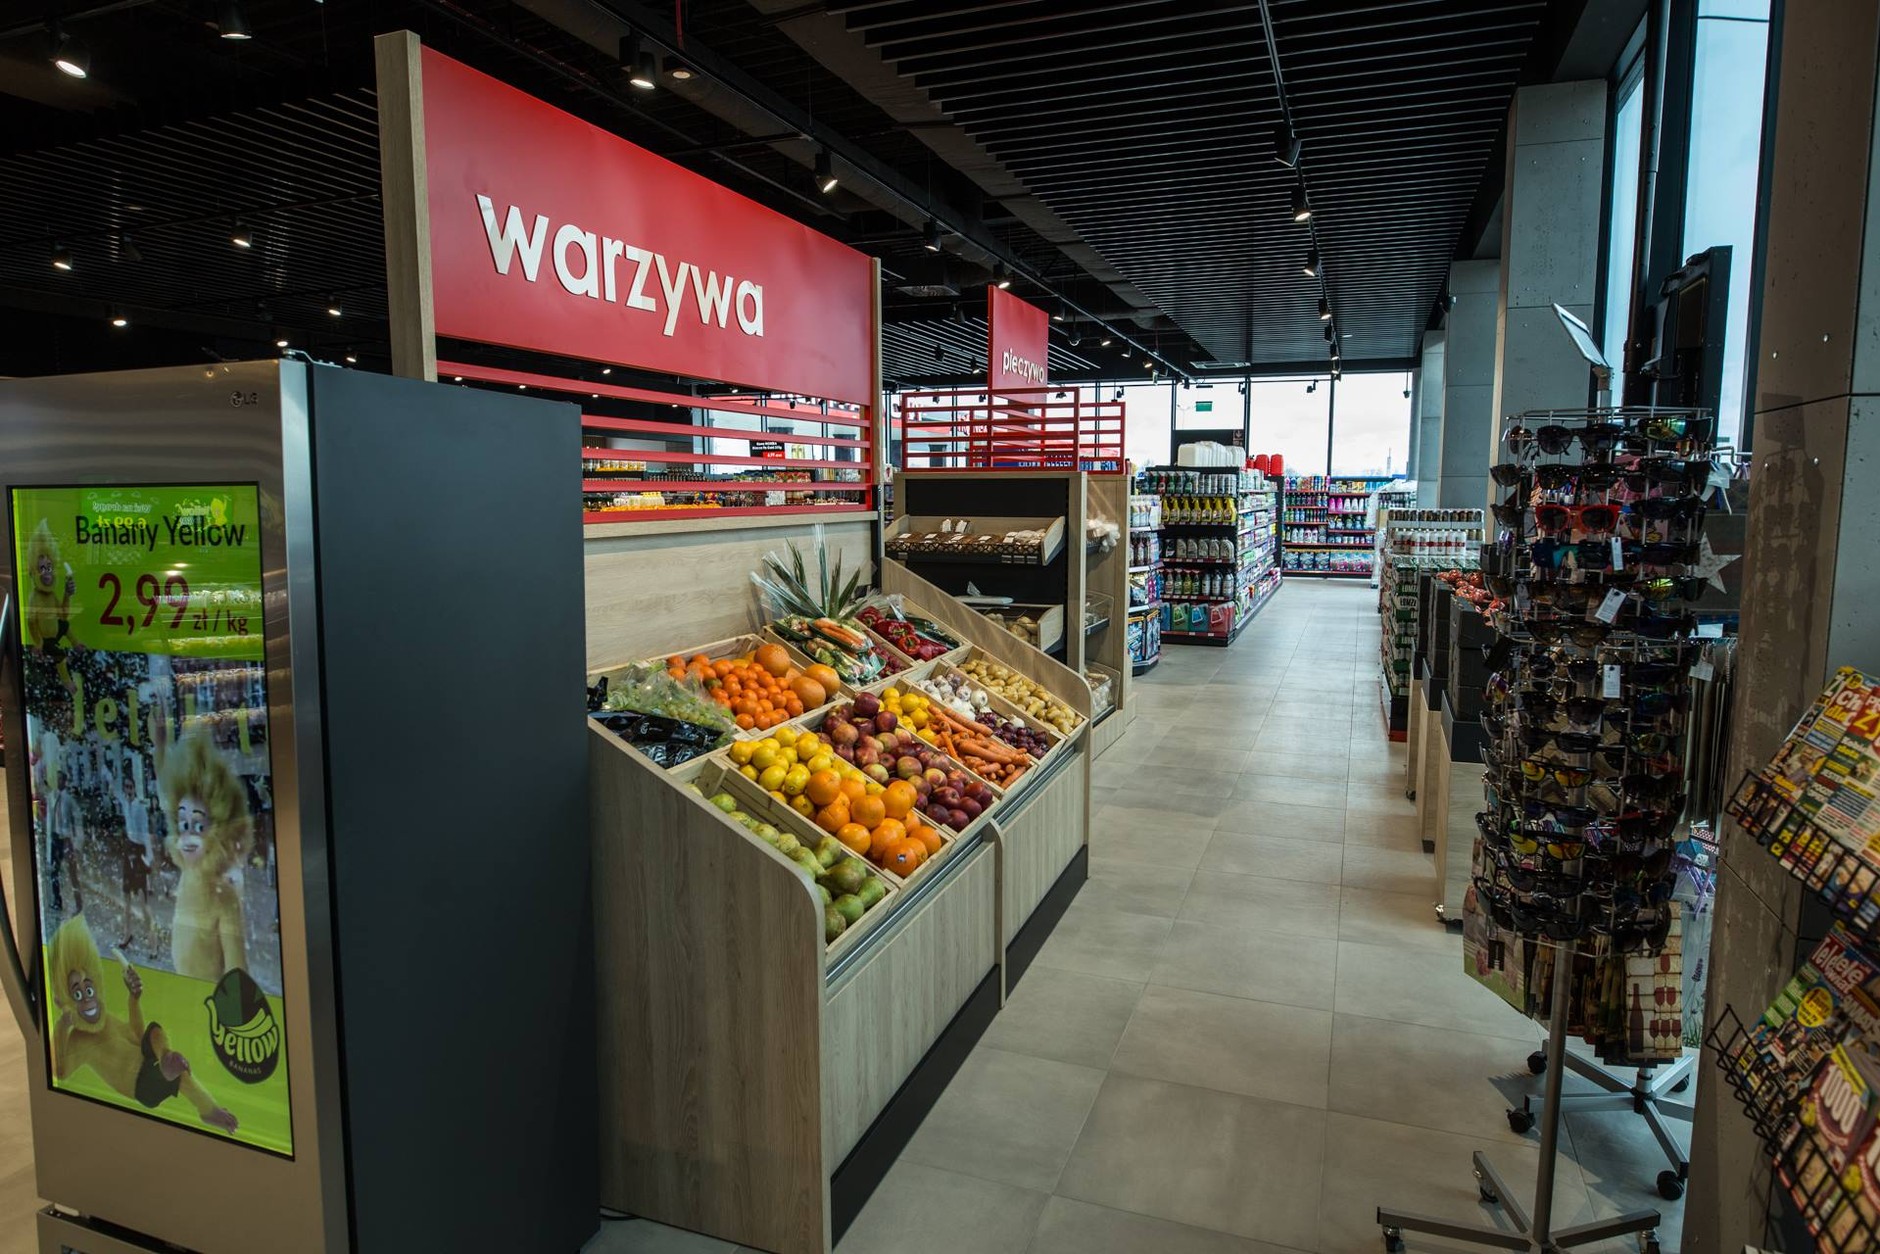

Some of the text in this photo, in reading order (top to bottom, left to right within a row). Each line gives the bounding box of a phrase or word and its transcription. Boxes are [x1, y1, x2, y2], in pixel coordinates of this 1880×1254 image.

[476, 194, 763, 337] warzywa
[1002, 347, 1044, 383] pieczywo
[75, 515, 245, 551] Banany Yellow
[98, 573, 189, 635] 2,99
[193, 610, 208, 631] zł
[227, 610, 248, 635] kg
[1820, 1064, 1861, 1134] 1000
